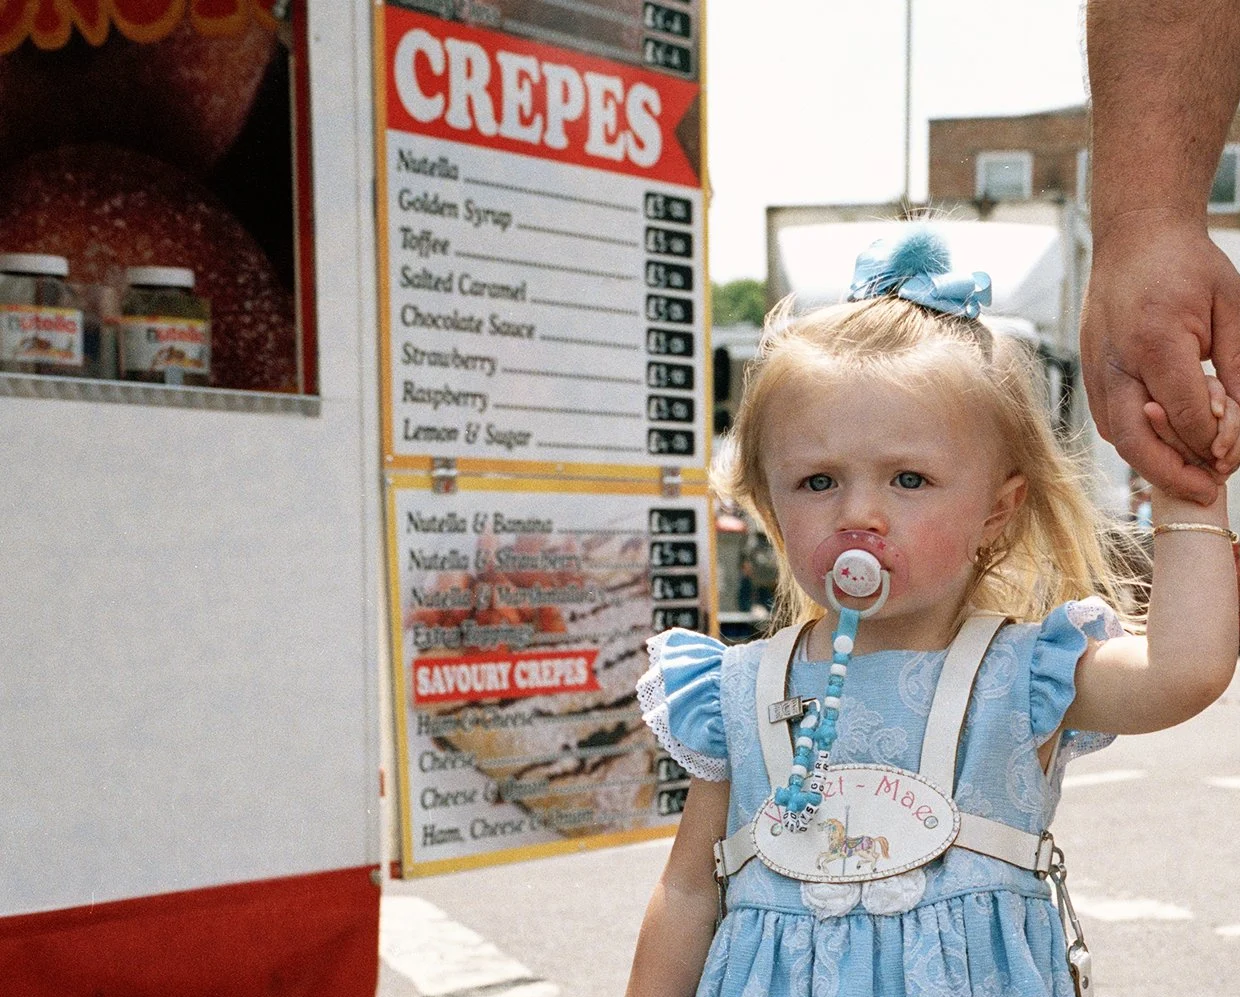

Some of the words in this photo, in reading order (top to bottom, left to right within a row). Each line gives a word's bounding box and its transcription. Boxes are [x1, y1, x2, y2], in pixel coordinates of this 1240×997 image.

[394, 28, 662, 168] CREPES
[398, 148, 459, 181] Nutella
[399, 188, 460, 219] Golden
[464, 199, 513, 233] Syrup
[400, 226, 450, 258] Toffee
[401, 265, 453, 293] Salted
[459, 273, 527, 302] Caramel
[401, 304, 483, 334] Chocolate
[488, 312, 535, 339] Sauce
[402, 342, 497, 378] Strawberry
[402, 380, 488, 414] Raspberry
[403, 418, 458, 442] Lemon
[484, 423, 532, 452] Sugar
[407, 511, 467, 534] Nutella
[493, 512, 553, 534] Banana
[409, 548, 469, 571] Nutella
[416, 661, 511, 696] SAVOURY
[514, 657, 588, 689] CREPES
[419, 750, 475, 773] Cheese
[420, 785, 478, 811] Cheese
[875, 775, 934, 822] Mae
[470, 816, 526, 840] Cheese
